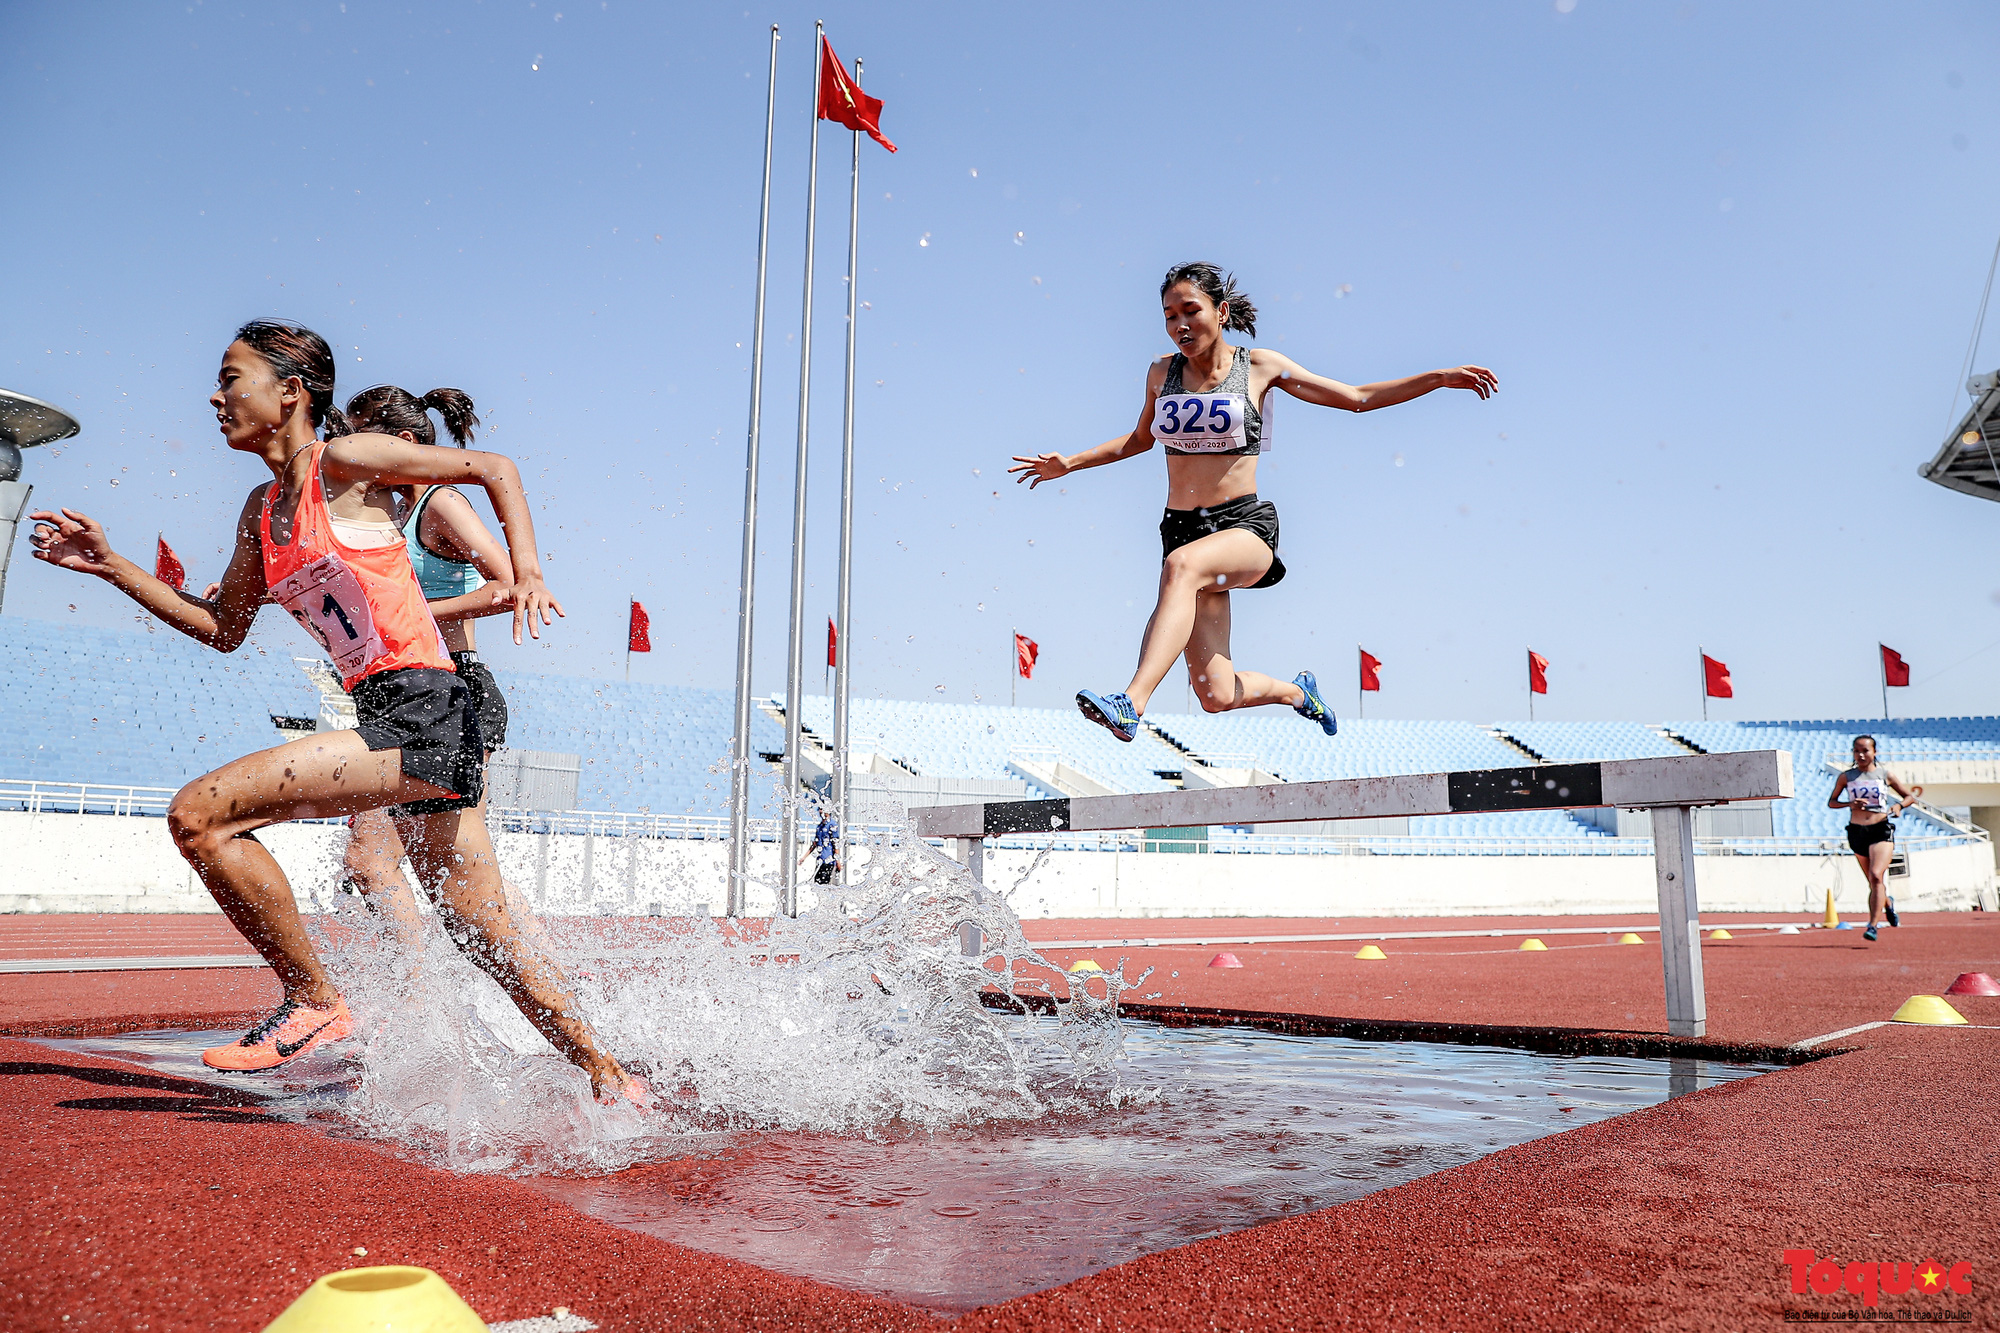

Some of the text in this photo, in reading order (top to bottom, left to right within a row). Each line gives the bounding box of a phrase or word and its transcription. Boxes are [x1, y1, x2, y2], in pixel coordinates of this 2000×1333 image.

[1158, 398, 1232, 435] 325
[1206, 441, 1227, 449] 2020
[1851, 786, 1881, 800] 123
